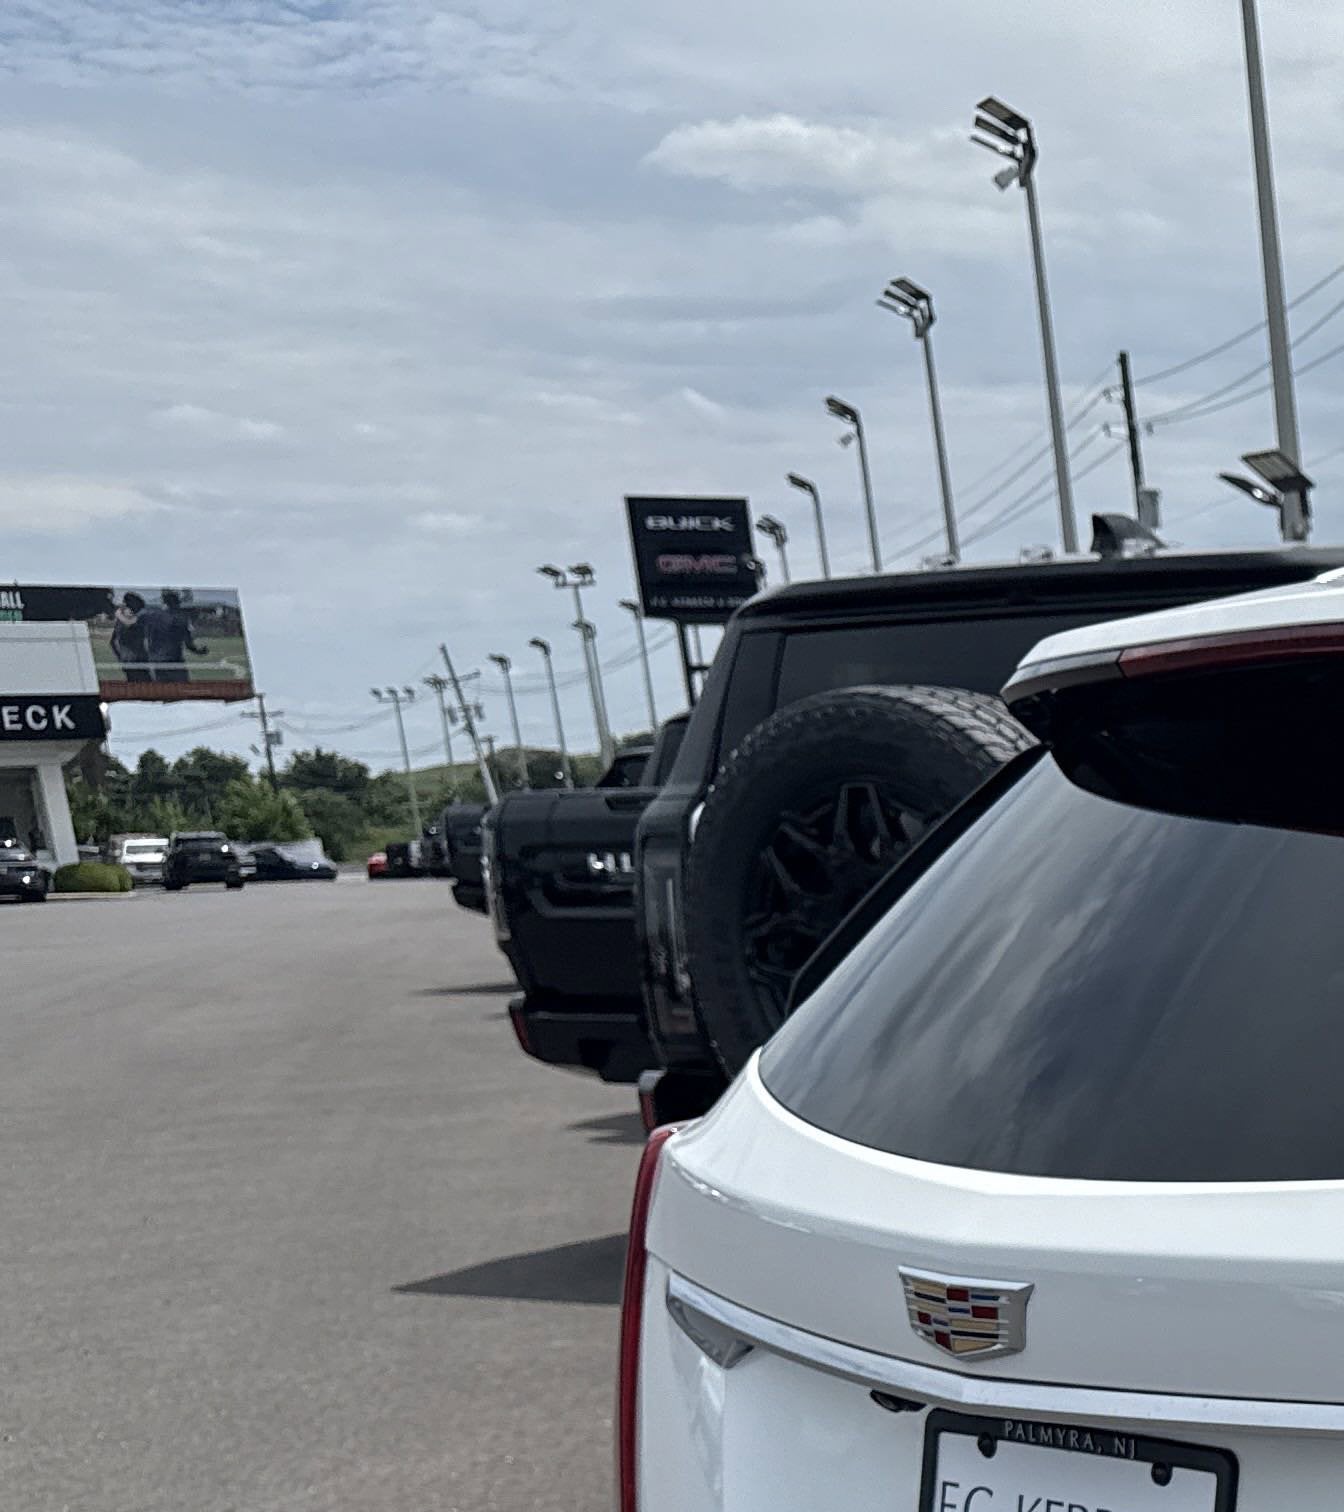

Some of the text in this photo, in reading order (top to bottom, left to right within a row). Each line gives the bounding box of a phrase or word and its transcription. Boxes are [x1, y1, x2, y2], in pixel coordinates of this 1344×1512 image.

[645, 515, 734, 532] BUICK
[656, 553, 737, 574] GMC
[1, 704, 76, 731] ECK
[1003, 1421, 1137, 1460] PALMYRA, NJ
